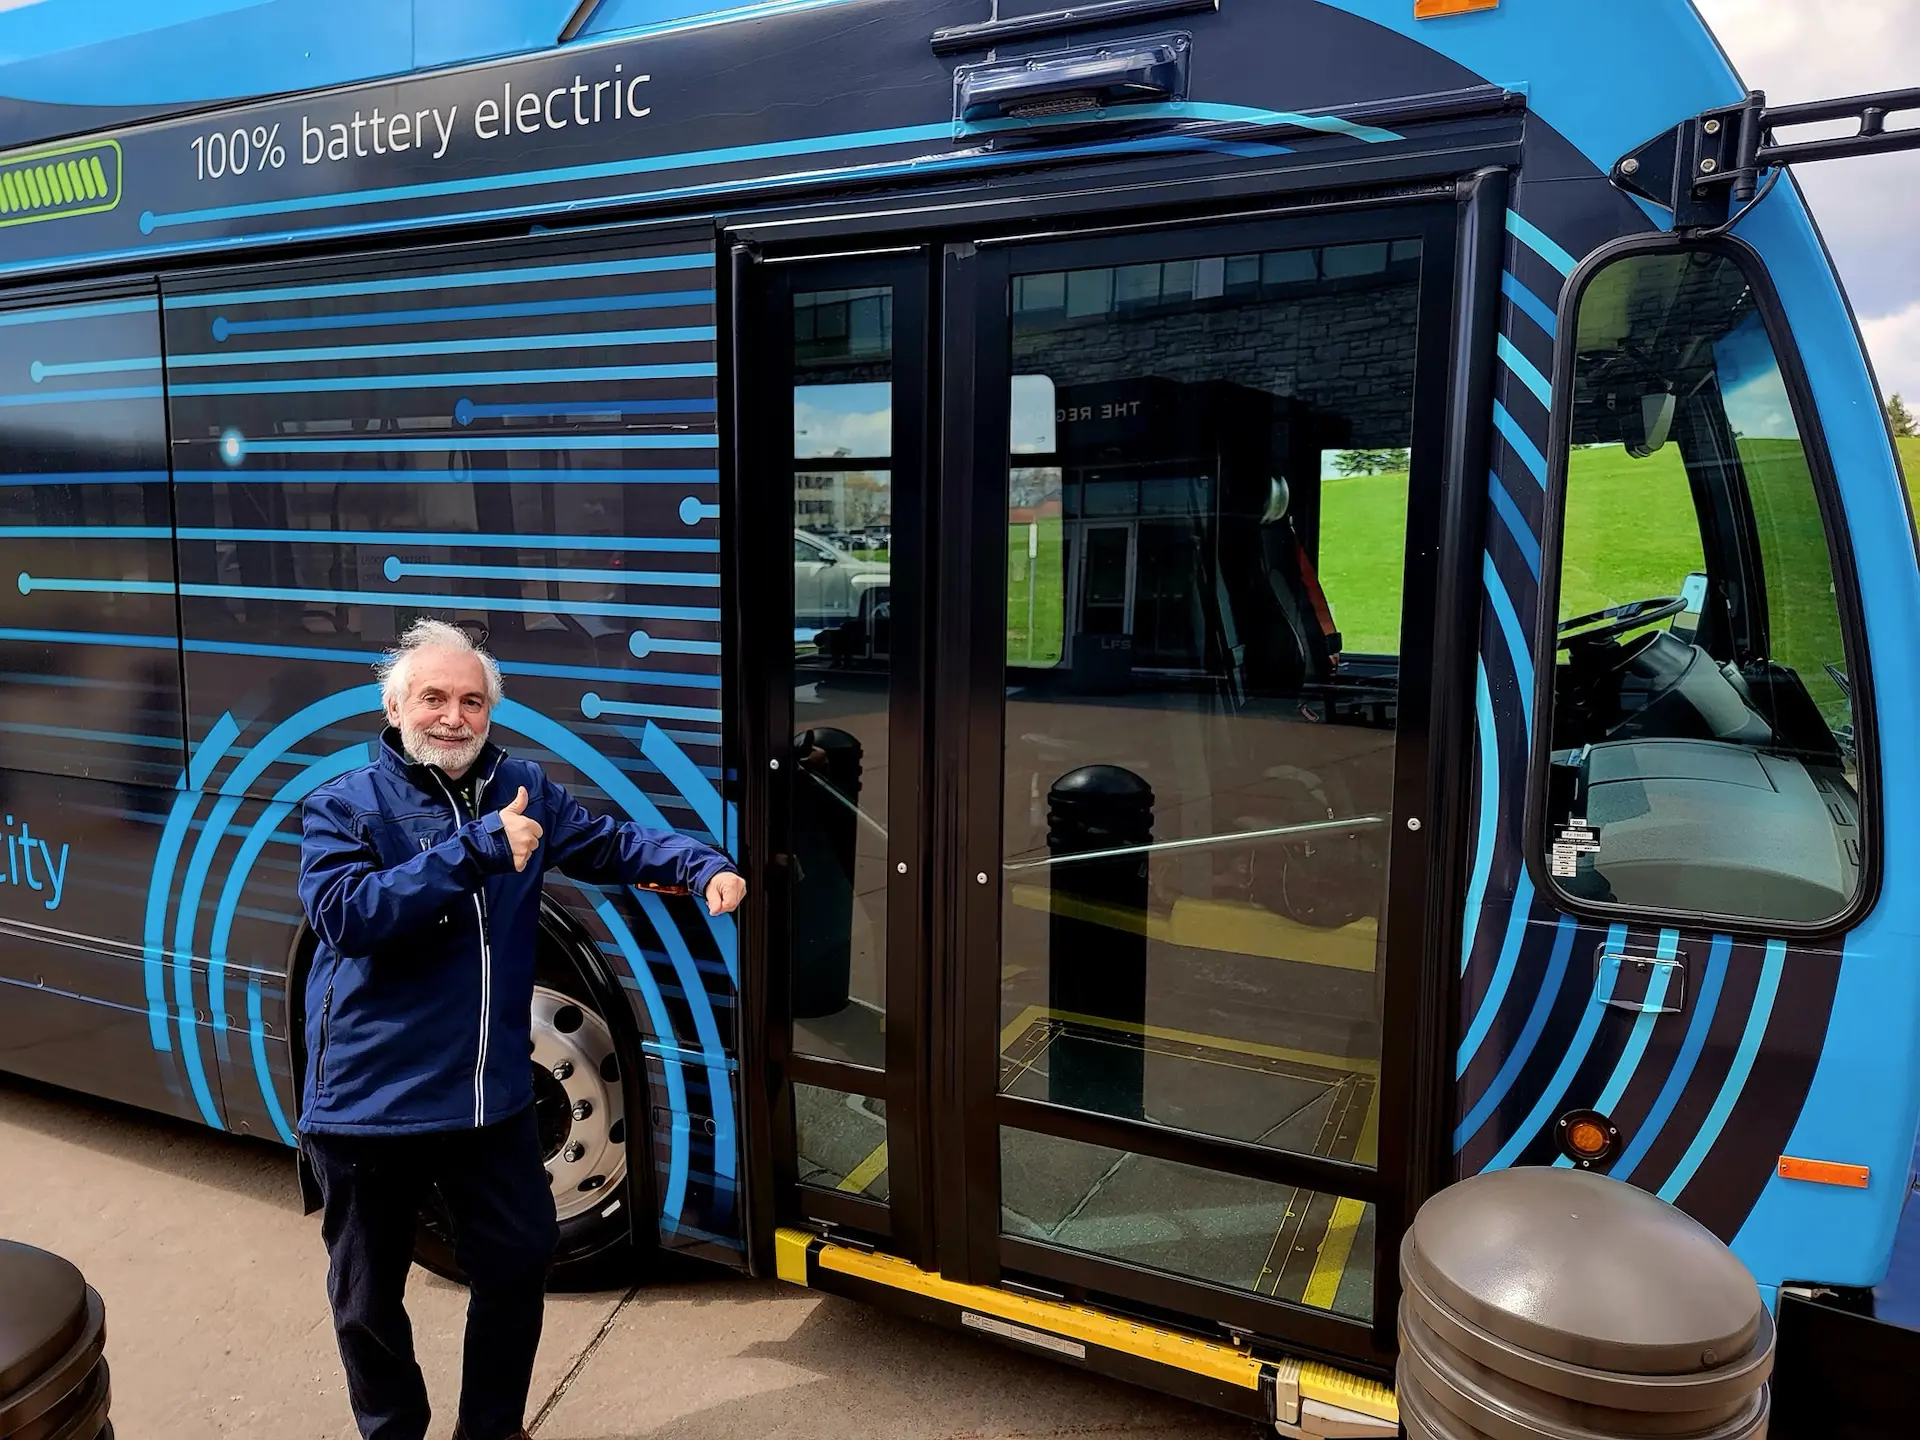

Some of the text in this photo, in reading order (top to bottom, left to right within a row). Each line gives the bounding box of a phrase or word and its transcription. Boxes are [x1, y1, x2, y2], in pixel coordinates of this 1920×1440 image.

[190, 63, 651, 181] 100% battery electric
